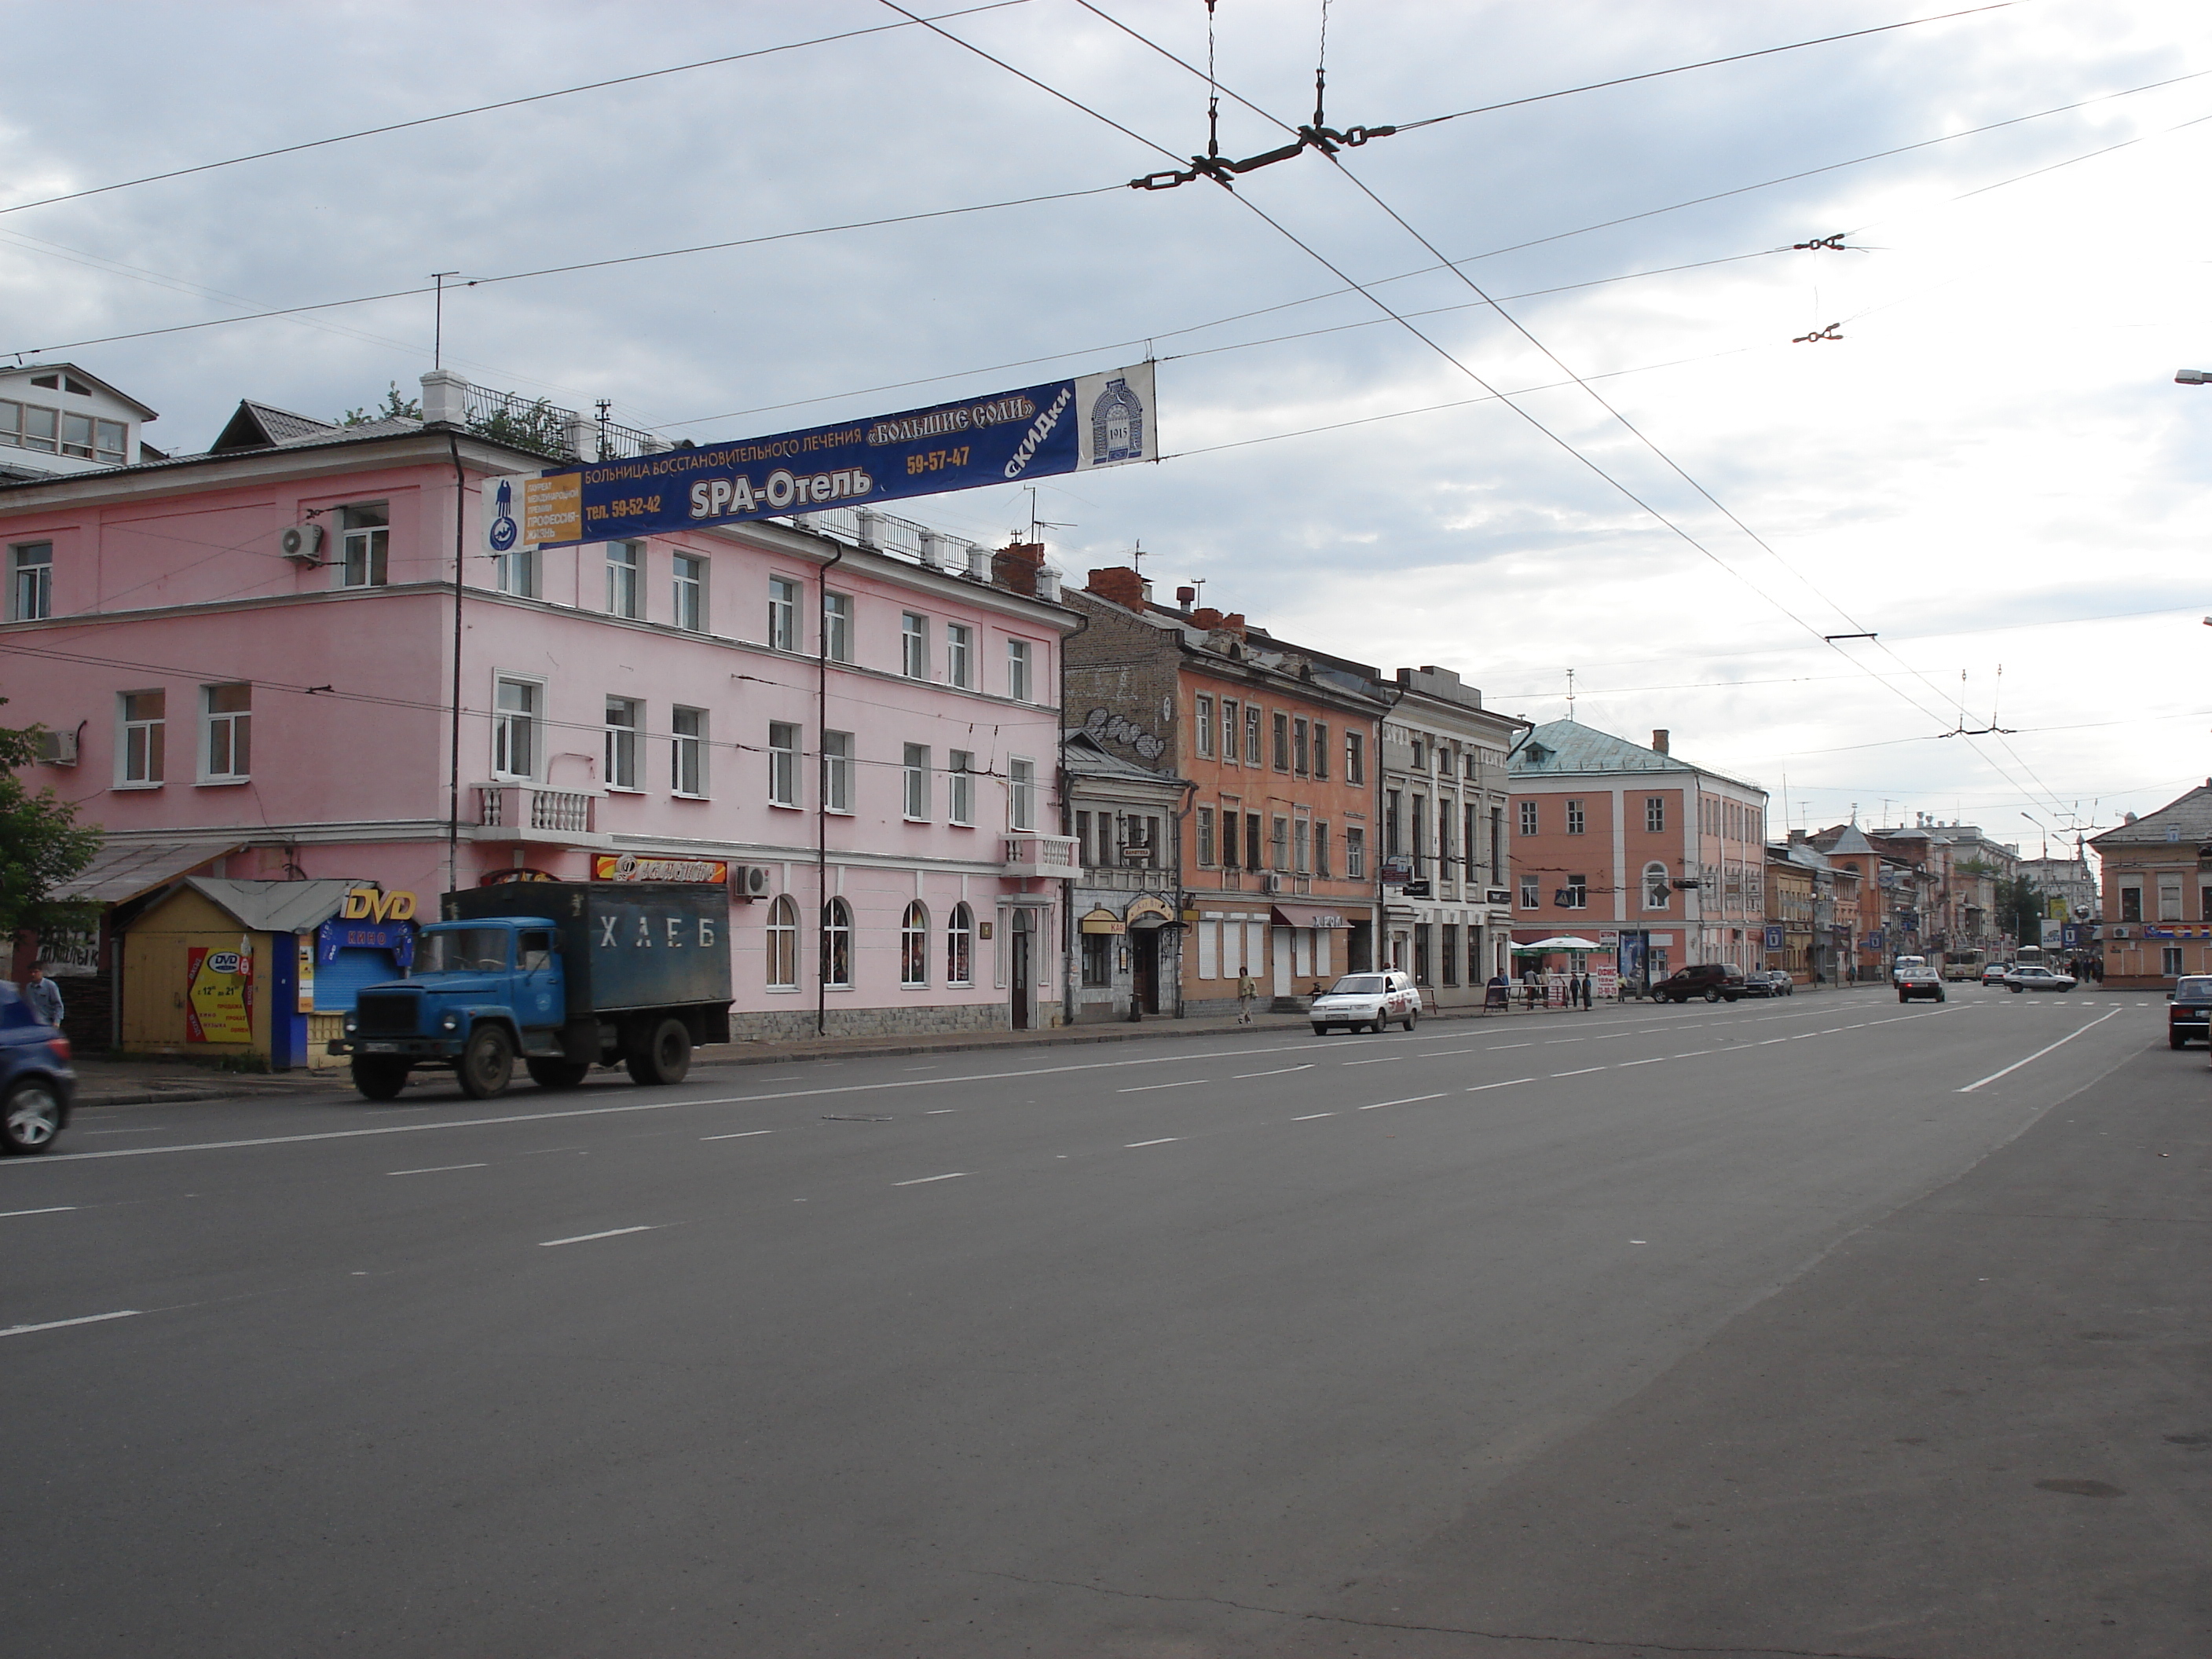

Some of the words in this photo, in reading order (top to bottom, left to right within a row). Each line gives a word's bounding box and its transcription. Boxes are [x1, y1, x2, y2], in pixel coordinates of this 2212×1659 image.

[1109, 428, 1127, 439] 1915
[585, 462, 651, 485] БОЛЬНИЦА
[653, 438, 800, 475] ВОССТАНОВИТЕЛЬНОГО
[802, 428, 862, 452] ЛЕЧЕНИЯ
[906, 446, 970, 475] 59-57-47
[526, 482, 552, 493] ЛАУРЕАТ
[690, 467, 872, 518] SPA-Отель
[526, 488, 580, 504] МЕЖДУНАРОДНОЙ
[527, 504, 552, 515] ПРЕМИИ
[586, 505, 609, 521] тел.
[611, 495, 661, 518] 59-52-42
[526, 528, 555, 541] ЖИЗНЬ
[342, 888, 417, 925] DVD
[348, 930, 386, 945] КИНО
[601, 916, 715, 948] ХЛЕБ
[214, 955, 237, 965] DVD
